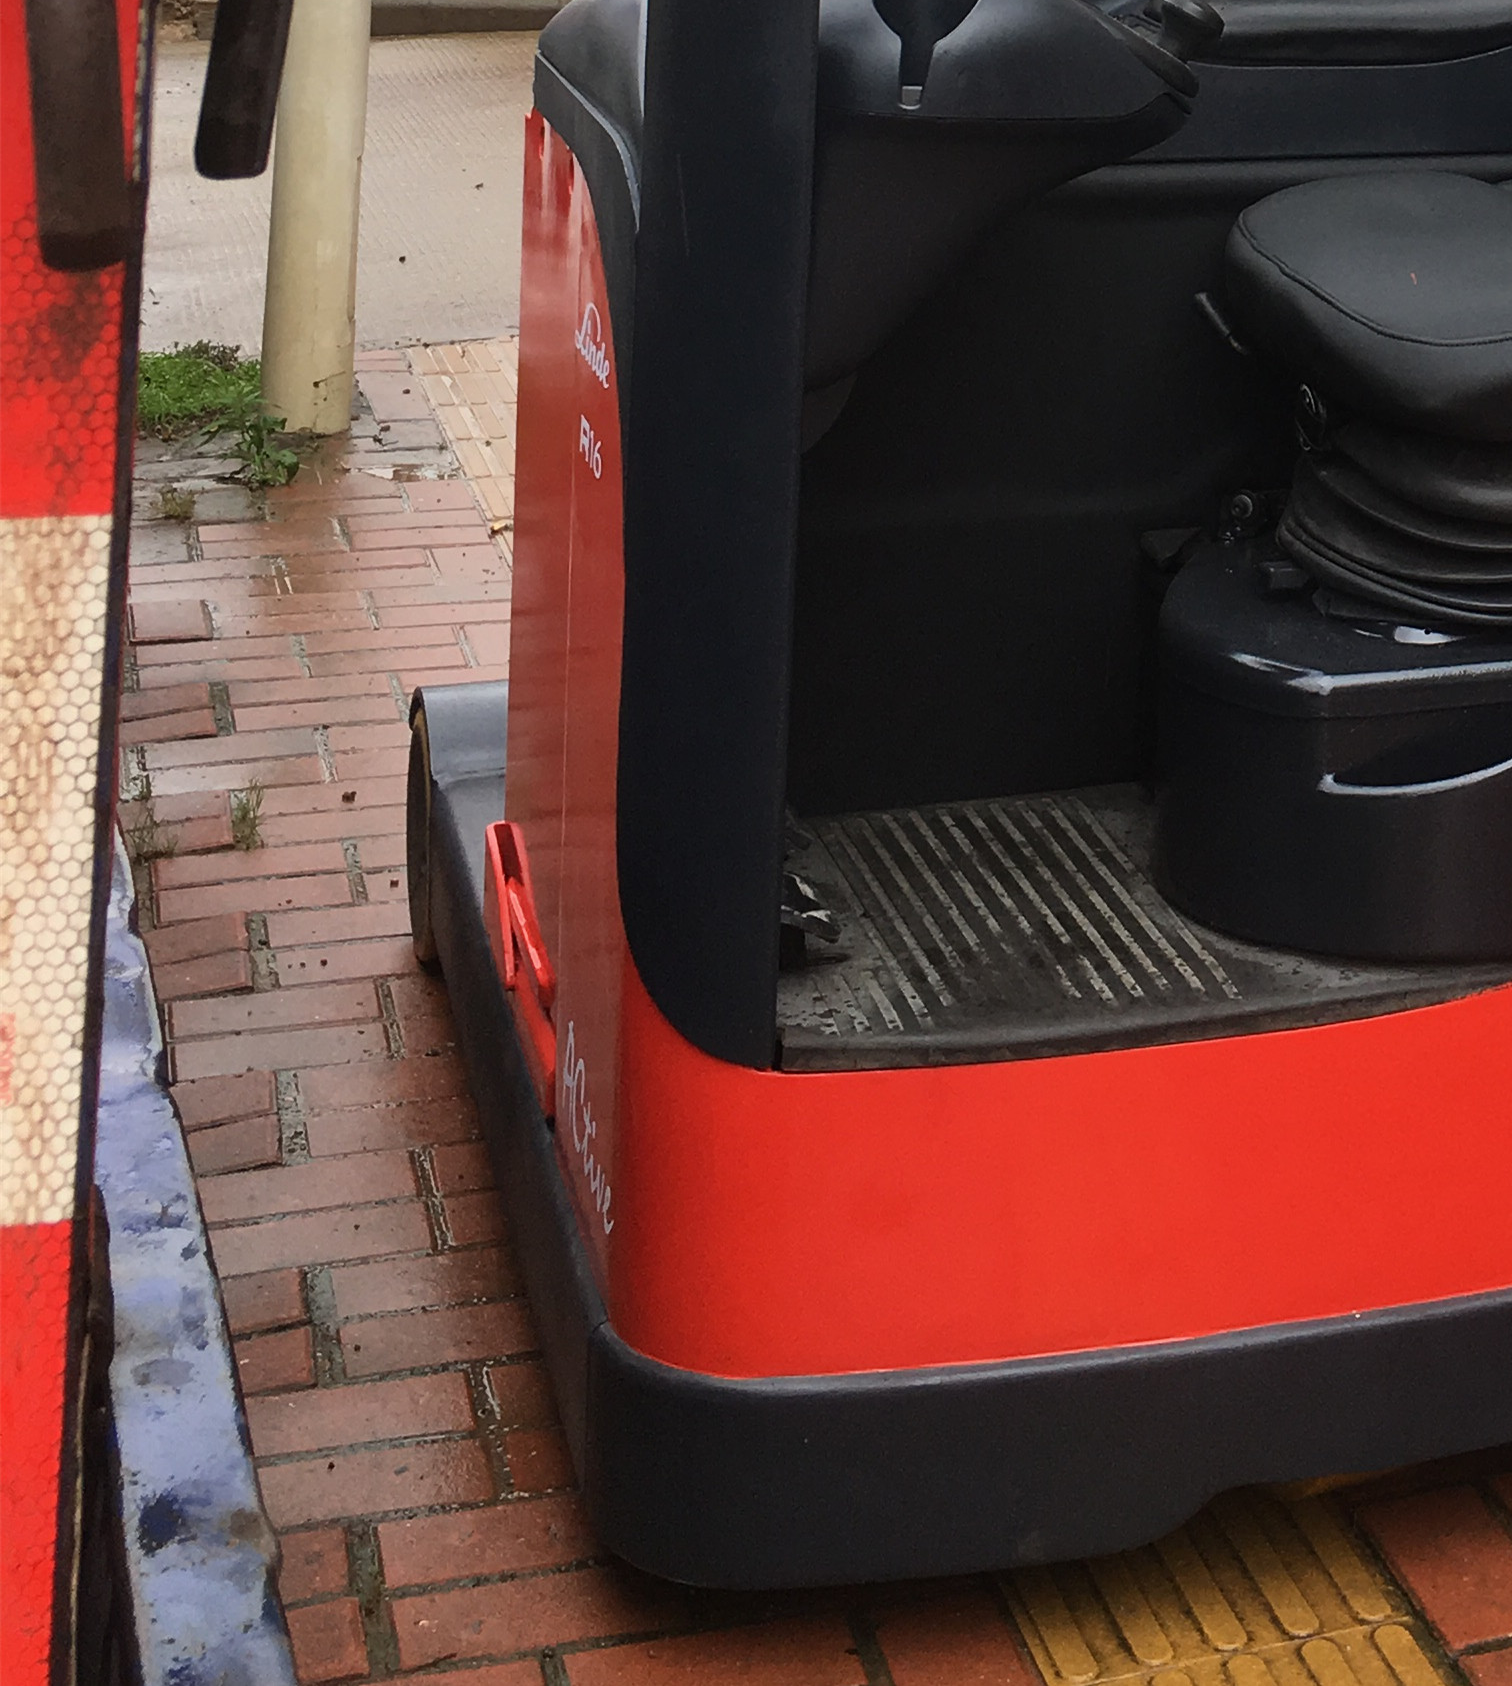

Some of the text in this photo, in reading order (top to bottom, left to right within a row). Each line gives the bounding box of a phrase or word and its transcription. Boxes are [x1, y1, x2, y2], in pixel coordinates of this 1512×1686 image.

[575, 302, 610, 389] Linde
[579, 414, 602, 480] R16
[562, 1020, 614, 1234] ACtive
